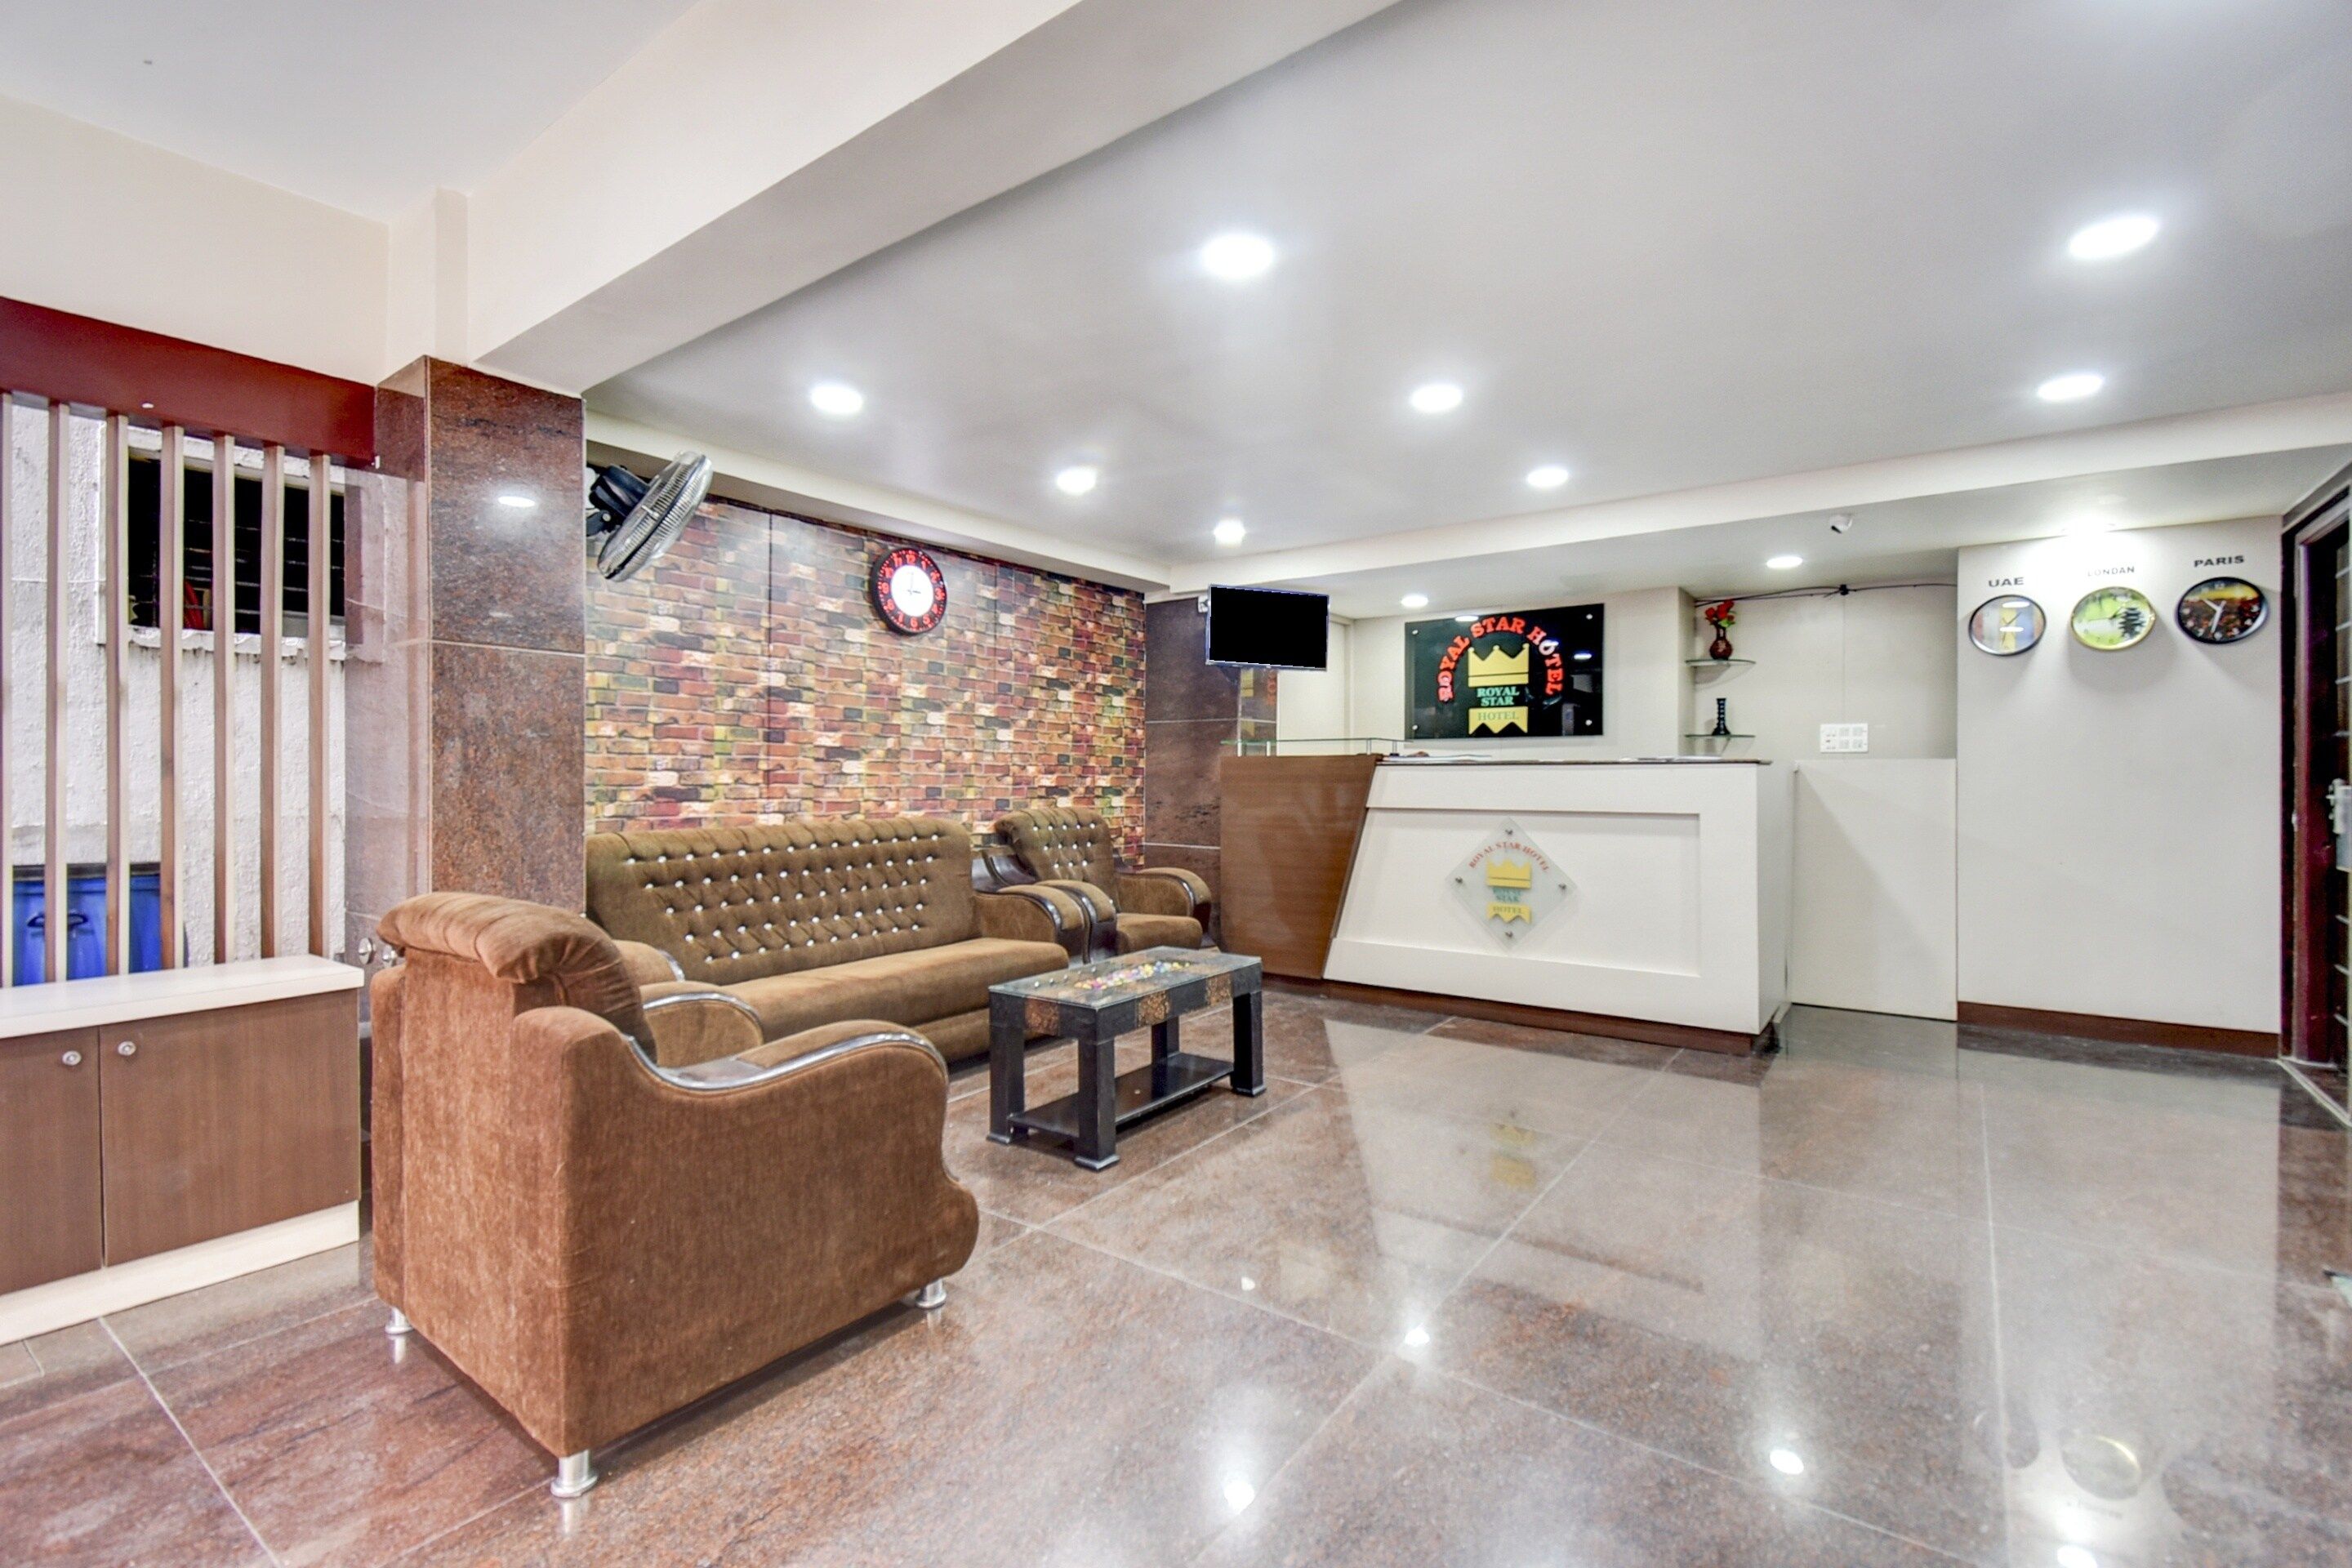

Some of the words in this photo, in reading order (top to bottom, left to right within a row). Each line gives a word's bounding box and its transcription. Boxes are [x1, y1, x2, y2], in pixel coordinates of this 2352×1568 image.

[2194, 555, 2244, 567] PARIS
[2087, 566, 2135, 577] LONDAN
[1989, 577, 2025, 587] UAE
[1437, 635, 1471, 702] ROYAL
[1470, 617, 1526, 638] STAR
[1526, 626, 1564, 695] HOTEL
[1477, 686, 1520, 697] ROYAL
[1481, 696, 1514, 706] STAR
[1477, 711, 1519, 722] HOTEL
